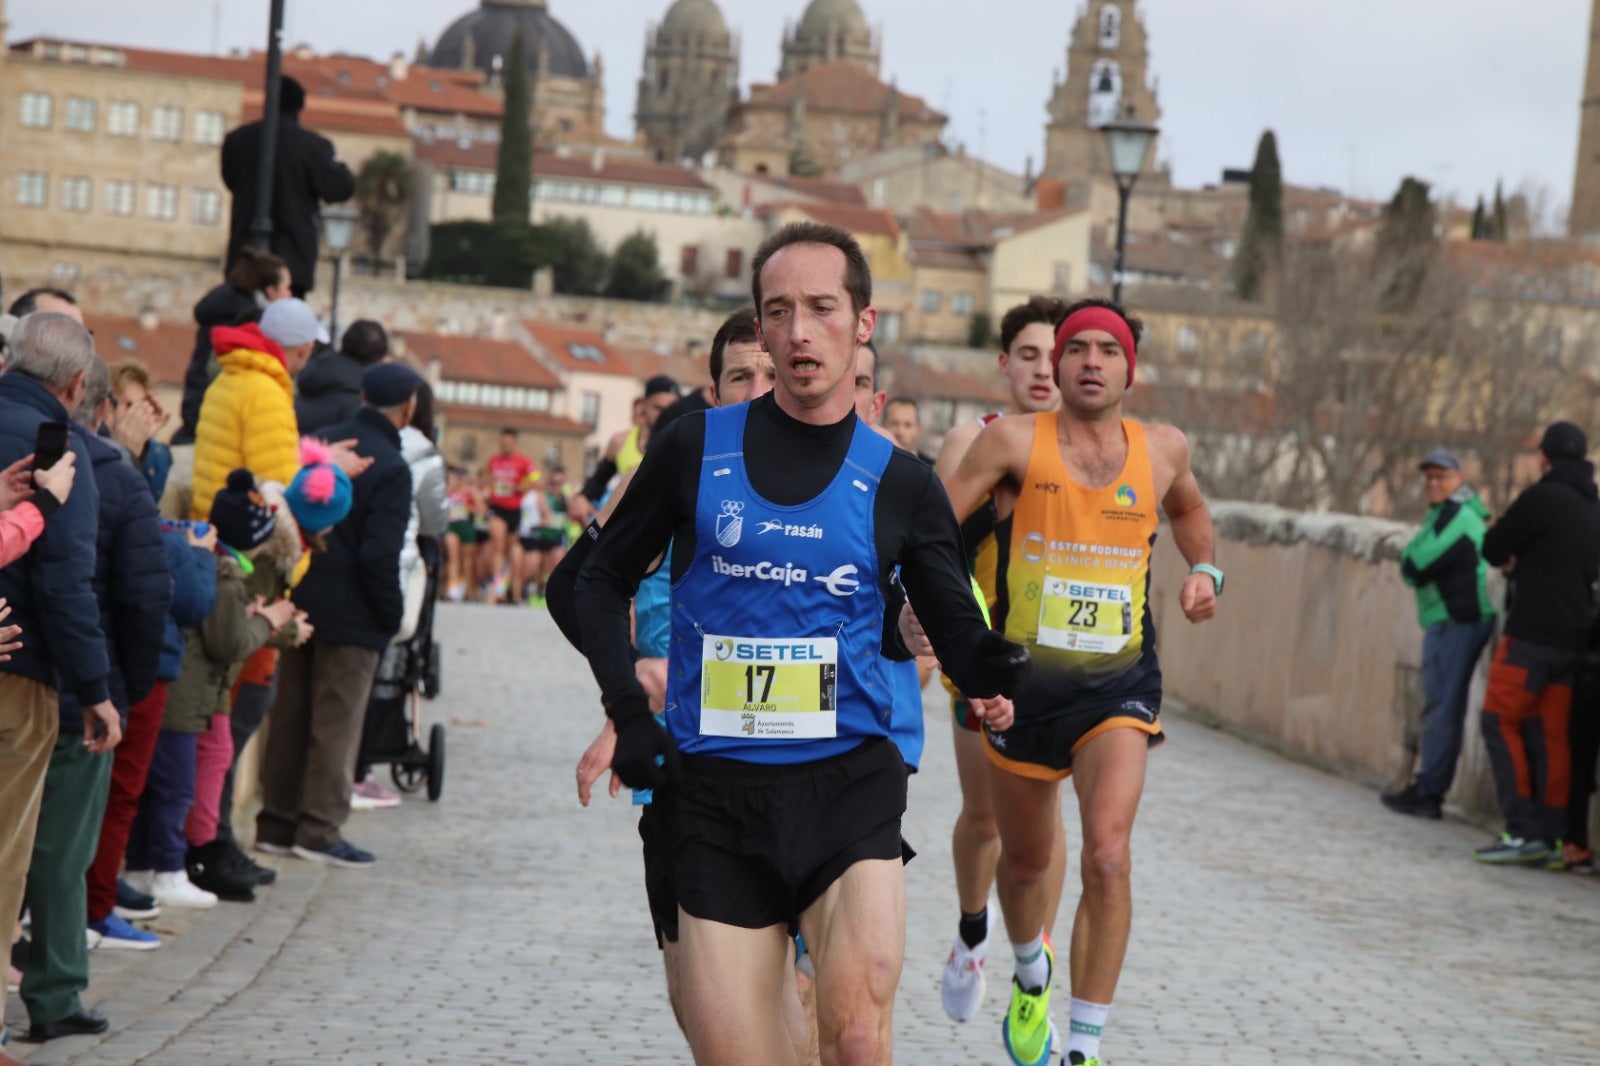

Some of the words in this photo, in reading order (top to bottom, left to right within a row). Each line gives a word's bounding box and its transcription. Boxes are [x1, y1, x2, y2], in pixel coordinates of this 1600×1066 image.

[784, 523, 823, 539] rasán
[1050, 541, 1087, 553] ESTER
[712, 556, 807, 586] iberCaja
[1069, 584, 1126, 601] SETEL
[1068, 599, 1099, 628] 23
[736, 643, 823, 660] SETEL
[745, 665, 775, 703] 17
[757, 720, 795, 728] Ayuntamiento
